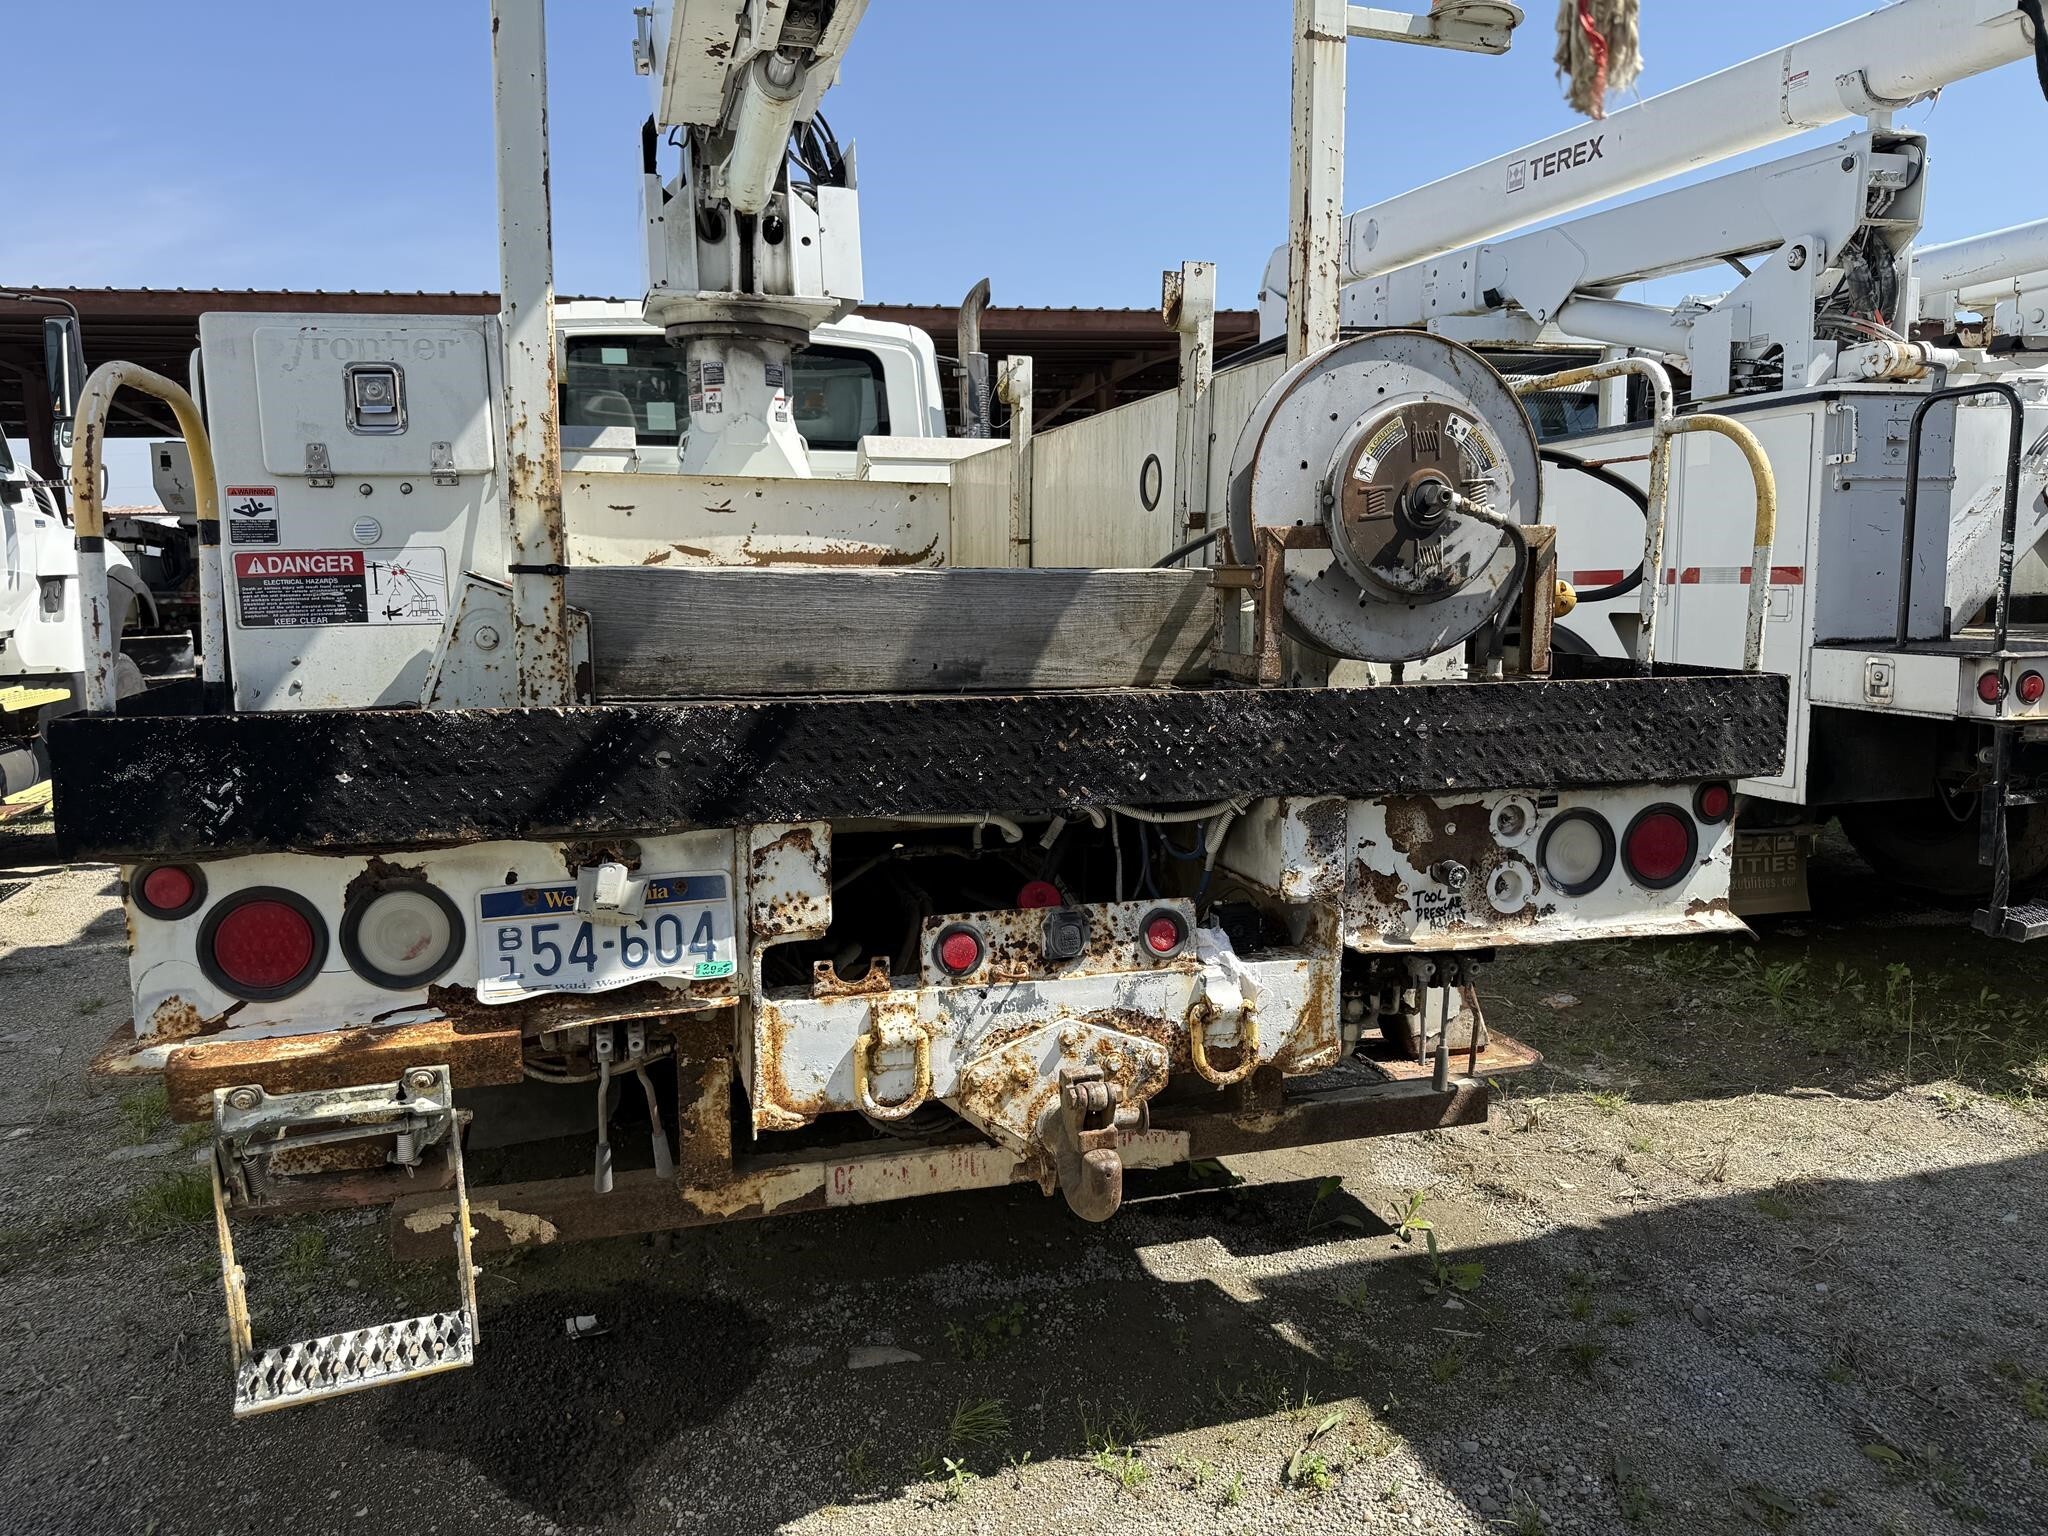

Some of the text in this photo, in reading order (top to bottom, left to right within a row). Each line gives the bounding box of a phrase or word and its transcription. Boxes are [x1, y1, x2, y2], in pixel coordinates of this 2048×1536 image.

[1530, 134, 1604, 181] TEREX
[1476, 435, 1496, 464] CAUTION
[267, 555, 355, 574] DANGER
[263, 578, 305, 586] ELECTRICAL
[274, 616, 328, 625] KEEP CLEAR
[1738, 855, 1797, 874] ITIES
[544, 890, 575, 908] We
[1412, 889, 1446, 907] TOOL
[1415, 896, 1462, 923] PRESSURE
[531, 910, 717, 978] 54-604
[554, 981, 591, 991] Wild,
